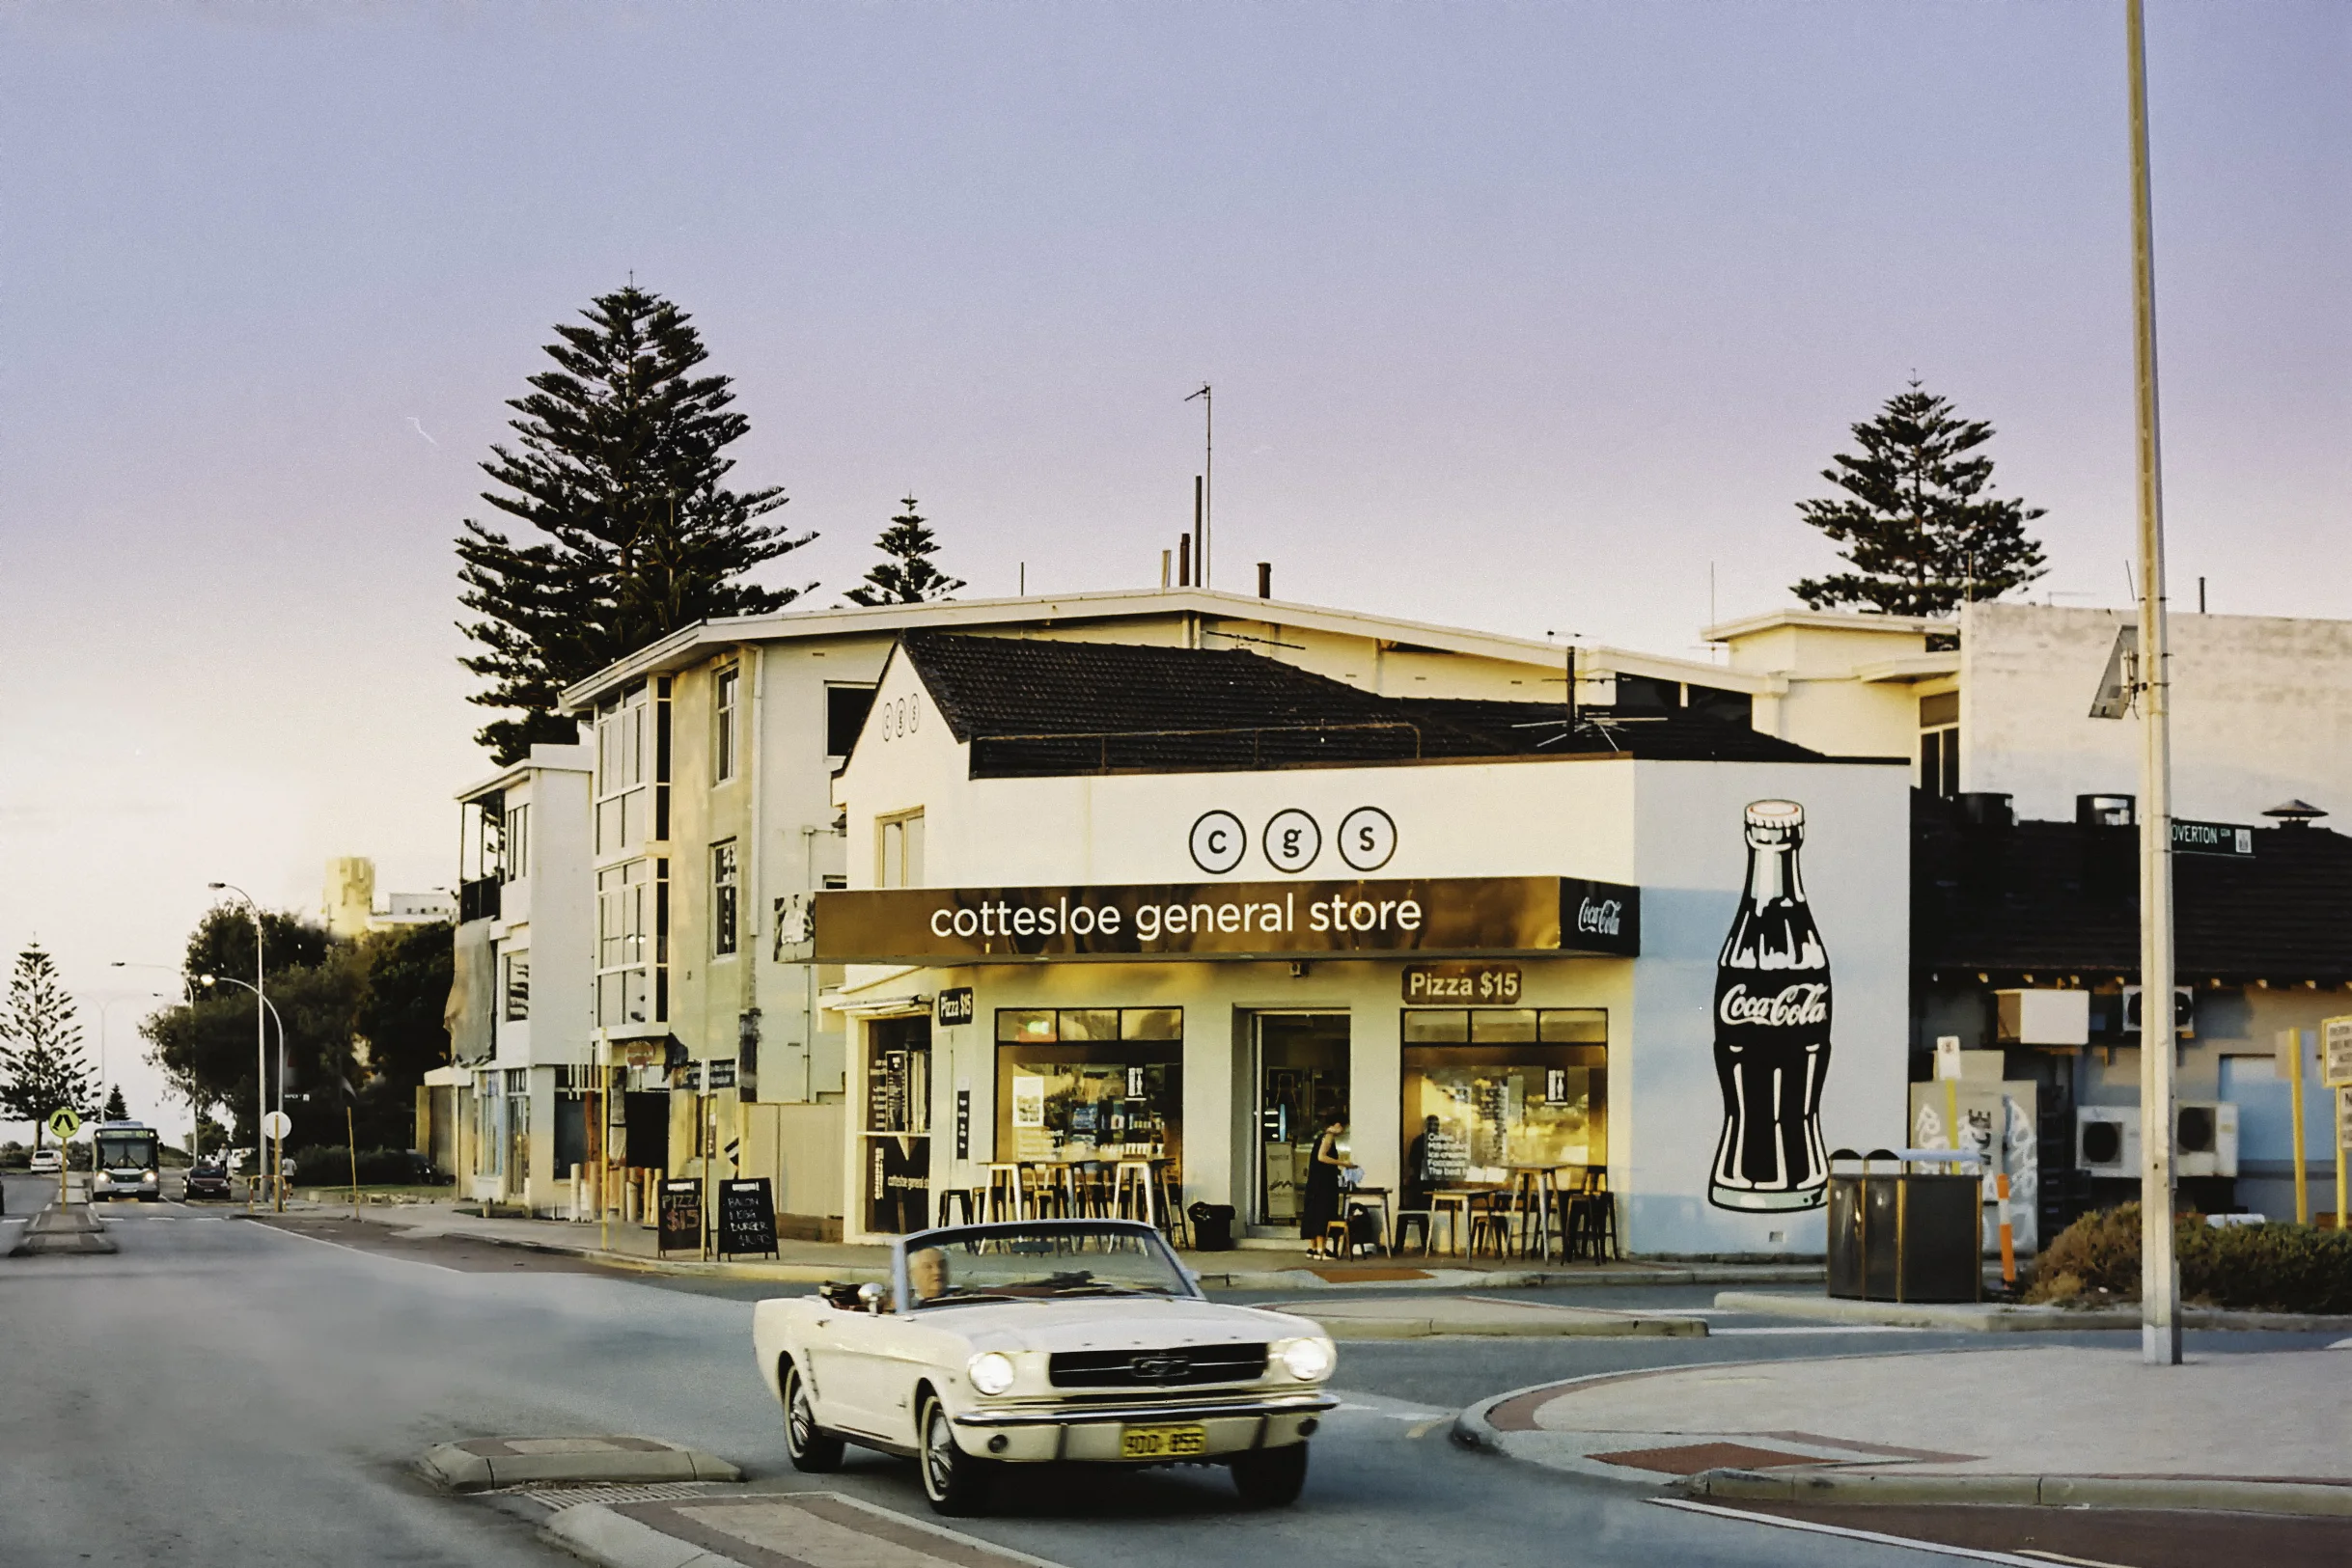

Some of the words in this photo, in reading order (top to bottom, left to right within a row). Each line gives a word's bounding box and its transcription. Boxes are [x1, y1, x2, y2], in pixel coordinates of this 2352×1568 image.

[1207, 830, 1227, 854] c
[1283, 828, 1302, 858] g
[1359, 826, 1375, 852] s
[2171, 824, 2218, 844] OVERTON
[930, 896, 1121, 937] cottesloe
[1135, 893, 1294, 942] general
[1309, 894, 1423, 932] store
[1410, 972, 1473, 996] Pizza
[1480, 971, 1517, 998] $15
[941, 996, 959, 1018] Pizza
[666, 1208, 700, 1232] $15
